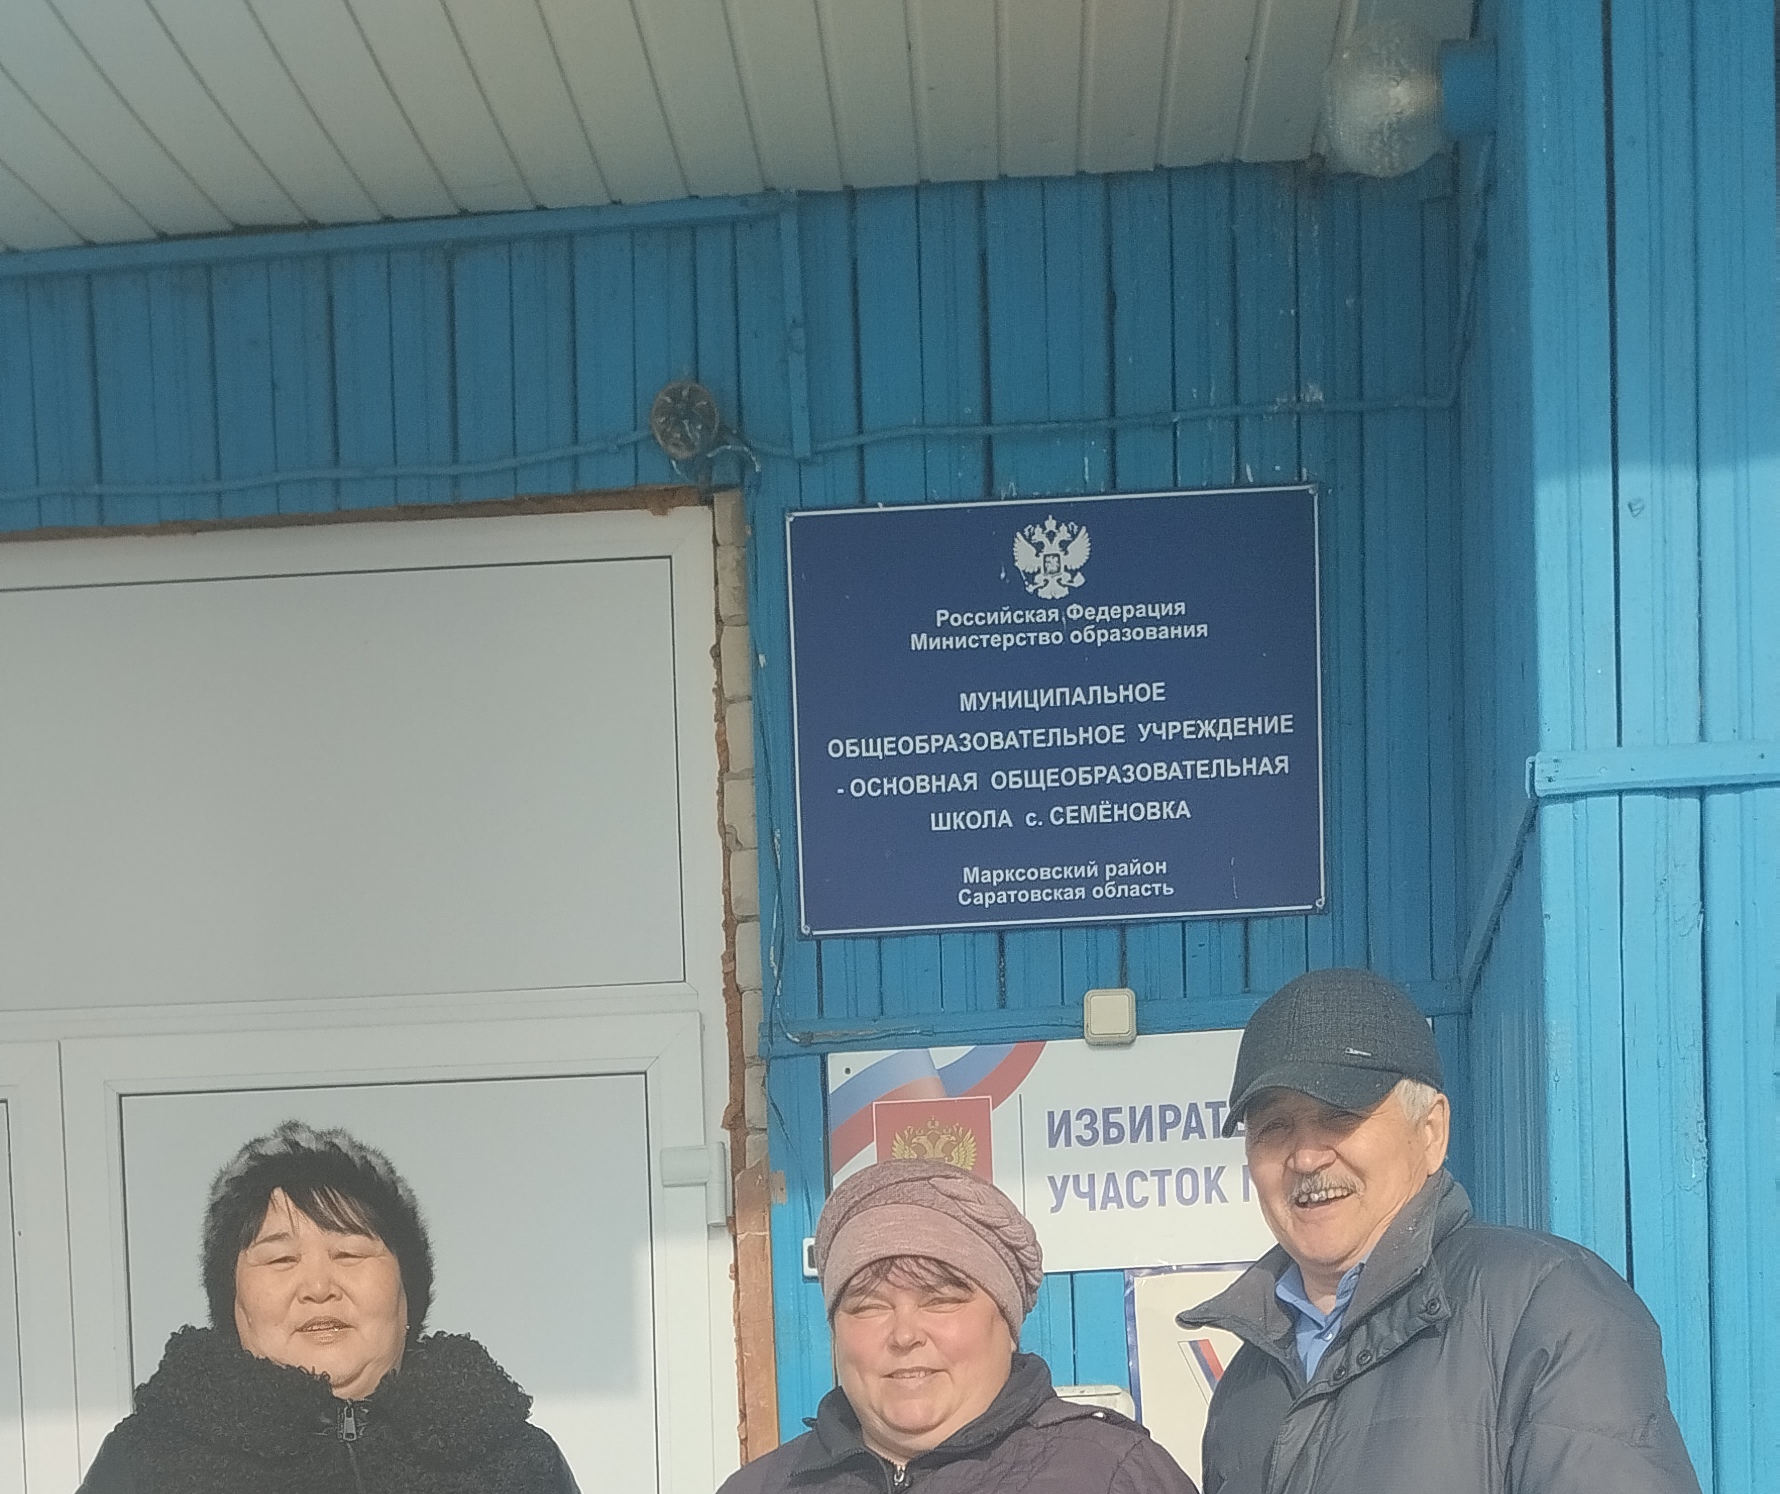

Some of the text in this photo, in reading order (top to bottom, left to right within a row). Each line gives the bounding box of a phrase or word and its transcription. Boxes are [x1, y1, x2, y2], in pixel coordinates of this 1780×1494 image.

[935, 600, 1187, 629] Российская Федерация
[910, 621, 1208, 651] Министерство образования
[959, 681, 1167, 713] МУНИЦИПАЛЬНОЕ
[827, 713, 1294, 760] ОБЩЕОБРАЗОВАТЕЛЬНОЕ УЧРЕЖДЕНИЕ
[990, 755, 1290, 792] ОБЩЕОБРАЗОВАТЕЛЬНАЯ
[930, 799, 1192, 831] ШКОЛА с. СЕМЁНОВКА
[962, 858, 1168, 885] Марксовский район
[957, 879, 1175, 908] Саратовская область
[1047, 1165, 1230, 1214] УЧАСТОК
